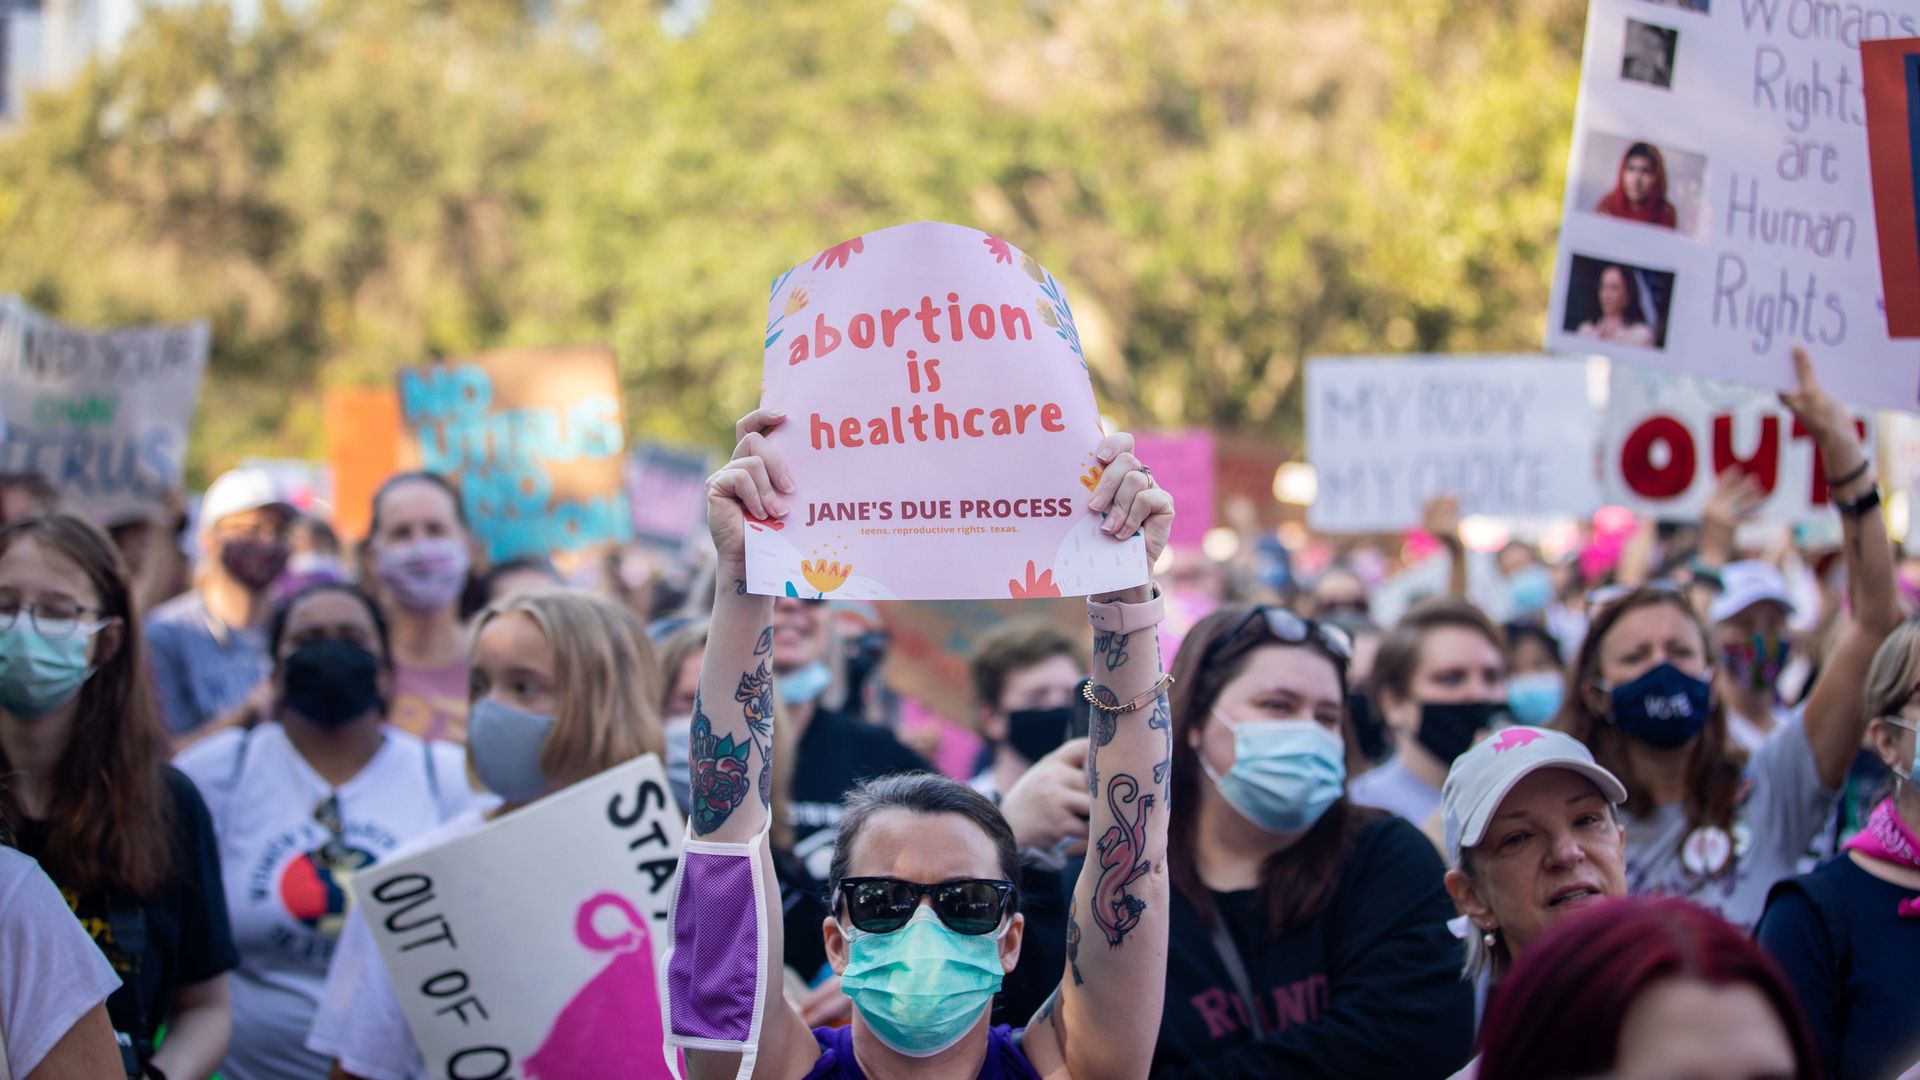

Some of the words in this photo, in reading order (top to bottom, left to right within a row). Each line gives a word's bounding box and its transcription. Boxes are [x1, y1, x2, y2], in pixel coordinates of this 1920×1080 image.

[1776, 137, 1840, 184] are
[1726, 173, 1857, 260] Human
[789, 292, 1032, 365] abortion
[1711, 252, 1848, 356] Rights
[401, 364, 493, 420] NO
[906, 350, 940, 393] is
[810, 402, 1065, 450] healthcare
[1322, 383, 1415, 440] MY
[1322, 456, 1406, 516] MY
[1622, 412, 1867, 505] OUT
[806, 501, 893, 526] JANE'S
[901, 500, 952, 520] DUE
[960, 498, 1073, 519] PROCESS
[861, 527, 890, 535] teens.
[893, 526, 955, 536] reproductive
[957, 525, 988, 535] rights.
[990, 525, 1019, 533] texas.
[606, 780, 681, 921] STA
[370, 873, 459, 952] OUT
[420, 968, 489, 1025] OF
